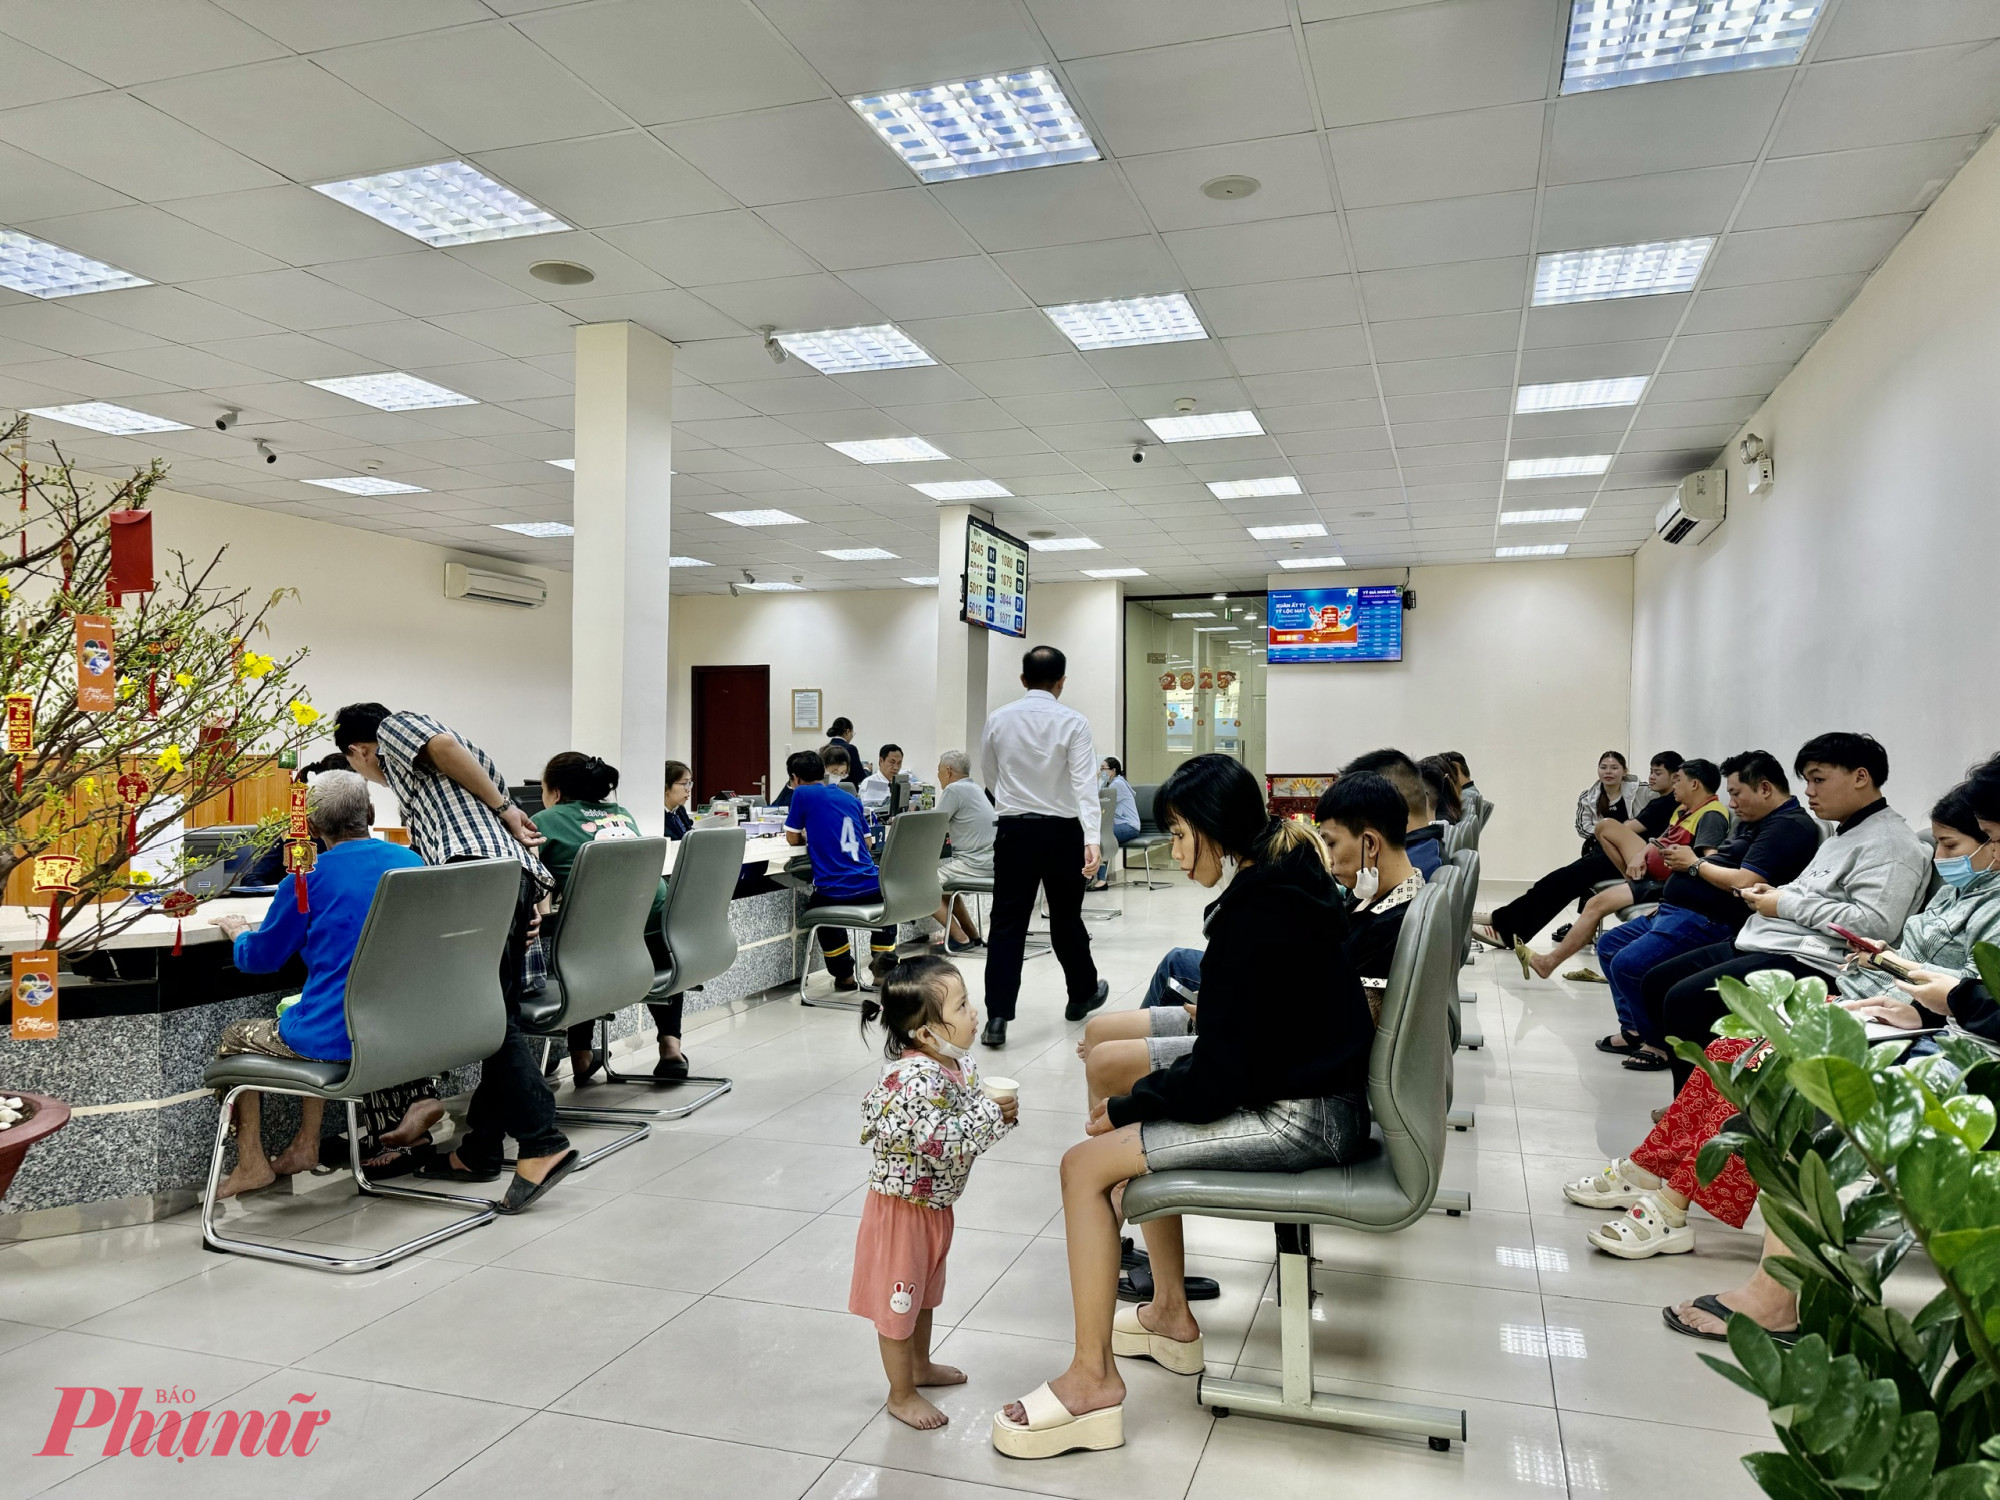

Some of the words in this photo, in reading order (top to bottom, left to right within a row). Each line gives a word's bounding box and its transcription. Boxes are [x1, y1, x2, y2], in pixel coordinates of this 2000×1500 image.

[970, 540, 984, 557] 3045
[989, 548, 995, 560] 01
[1001, 573, 1012, 588] 1079
[969, 581, 983, 596] 5017
[1000, 592, 1012, 607] 3044
[1016, 598, 1022, 610] 01
[968, 601, 982, 616] 5016
[987, 607, 993, 619] 01
[1160, 671, 1231, 690] 2025
[840, 816, 860, 862] 4
[878, 831, 884, 843] 2
